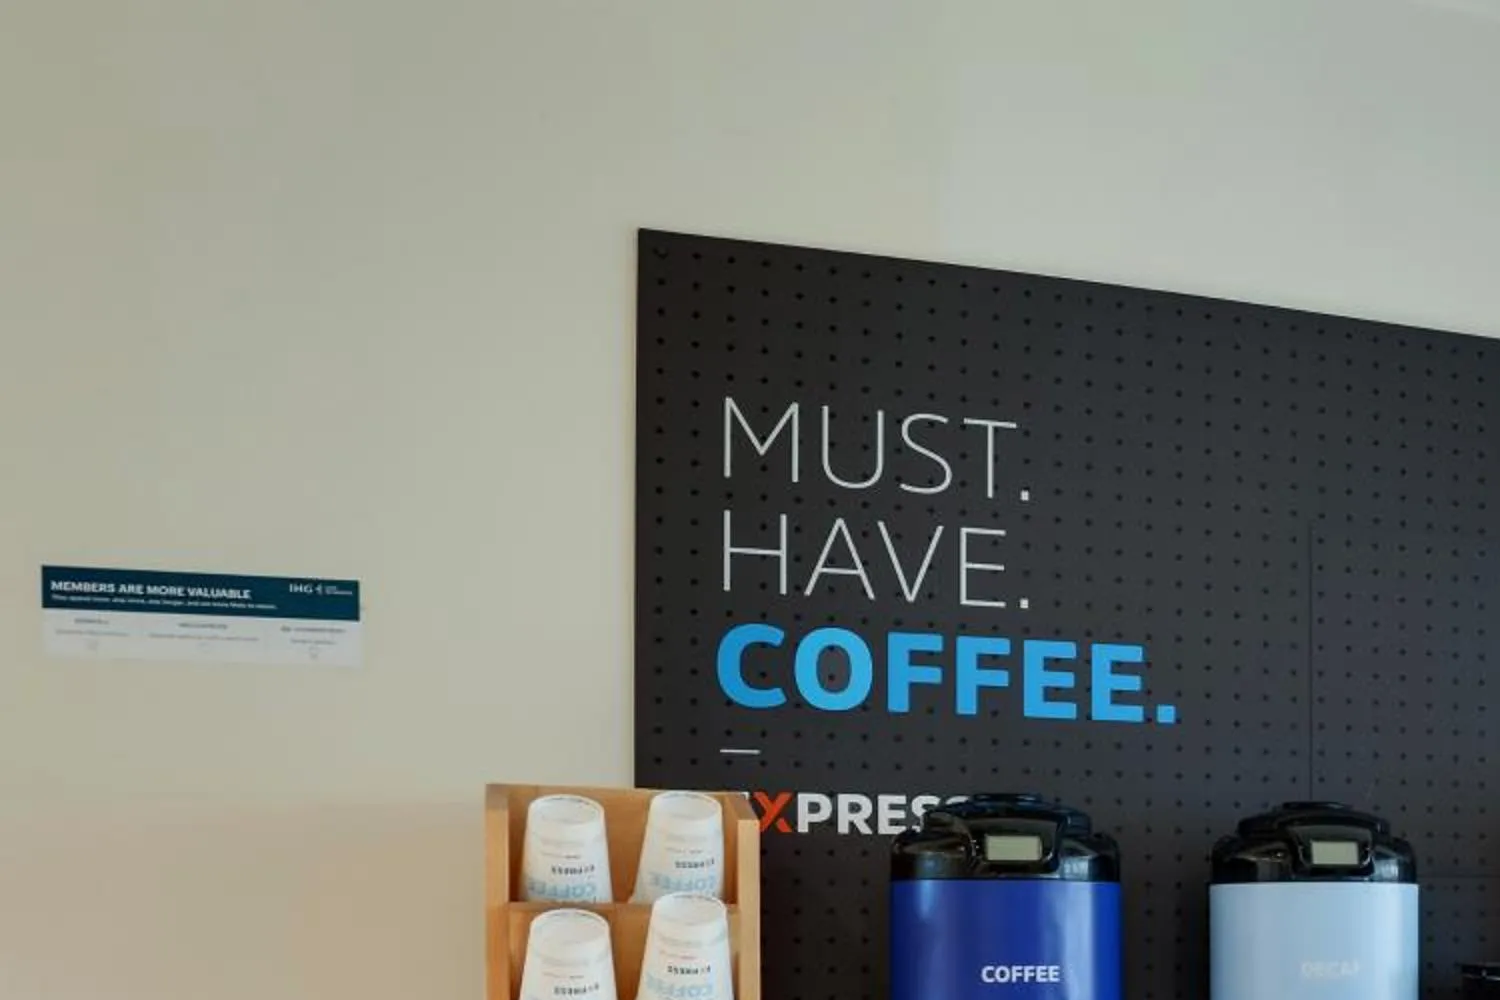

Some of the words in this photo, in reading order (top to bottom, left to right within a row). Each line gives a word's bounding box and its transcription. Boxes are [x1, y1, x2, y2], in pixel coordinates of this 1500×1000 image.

[725, 397, 1029, 500] MUST.
[723, 510, 1029, 608] HAVE.
[51, 581, 115, 593] MEMBERS
[119, 584, 144, 595] ARE
[147, 586, 185, 597] MORE
[289, 584, 312, 593] IHG
[715, 623, 1176, 724] COFFEE.
[748, 791, 968, 834] XPRES
[981, 965, 1061, 983] COFFEE
